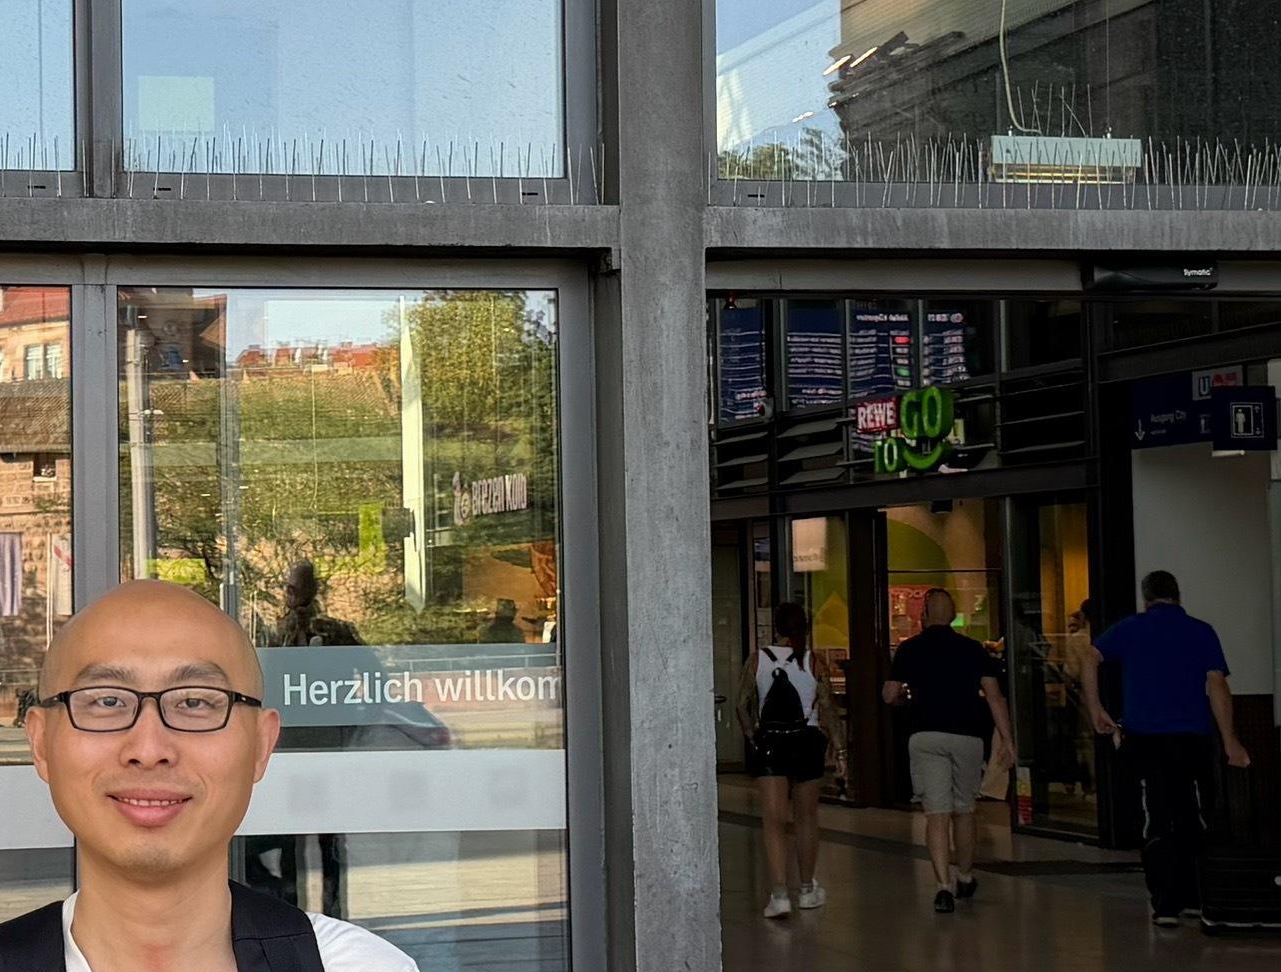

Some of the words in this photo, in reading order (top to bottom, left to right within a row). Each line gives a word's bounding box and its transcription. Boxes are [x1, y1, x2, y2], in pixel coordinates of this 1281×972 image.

[858, 401, 896, 430] REWE
[901, 386, 944, 439] GO
[283, 671, 423, 706] Herzlich
